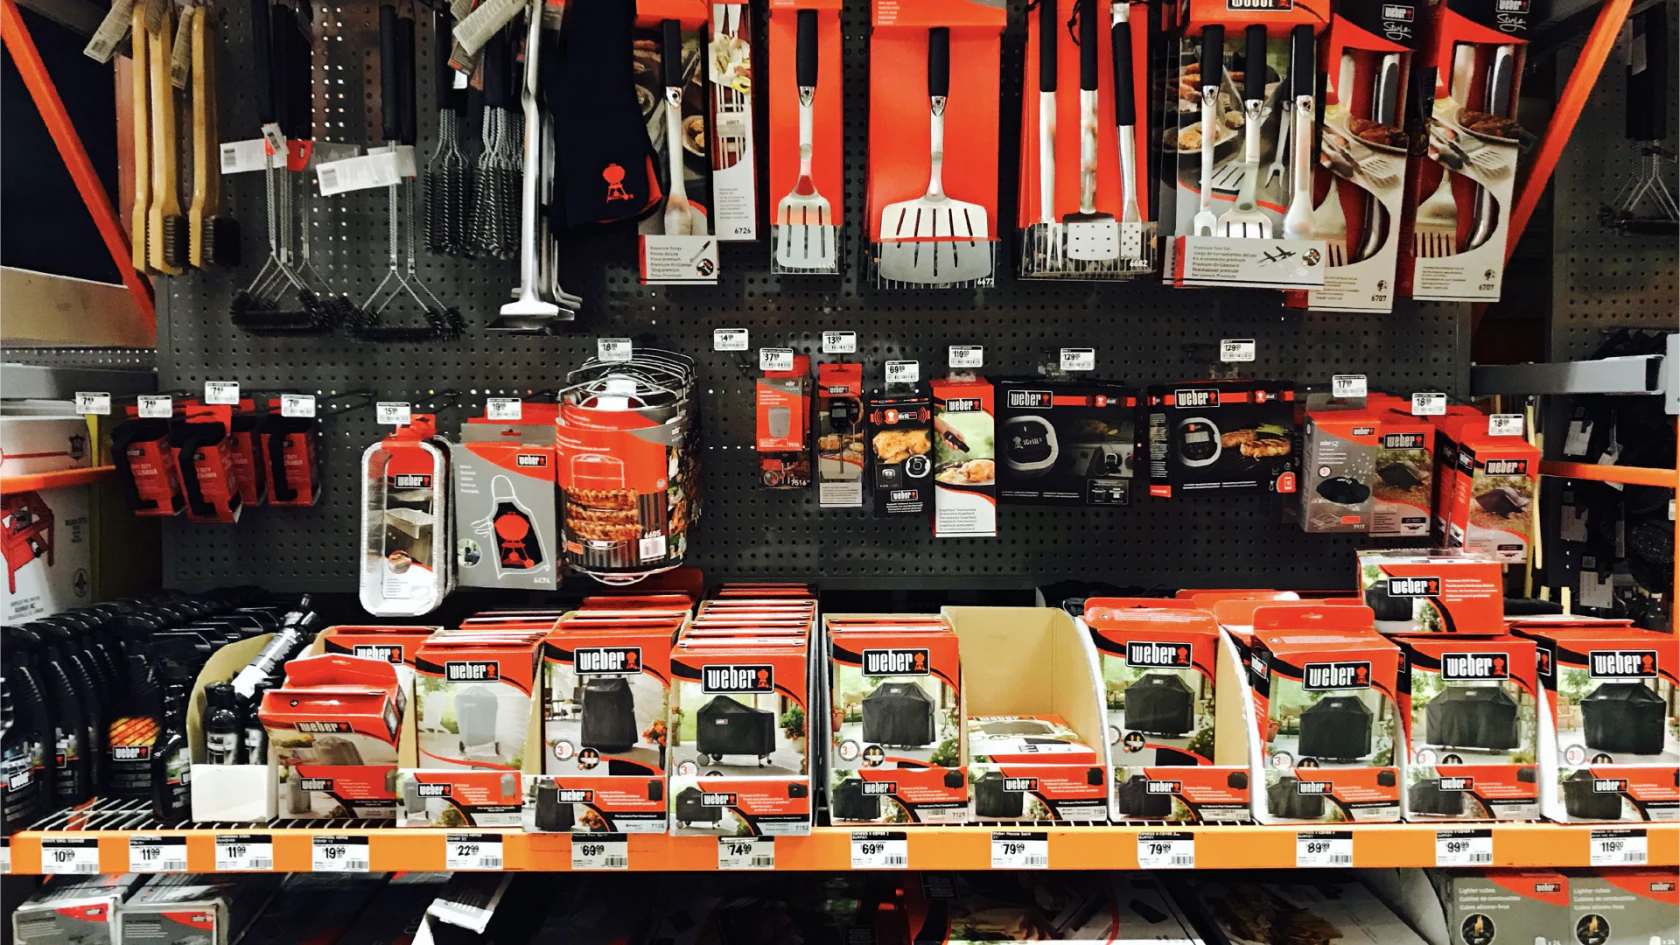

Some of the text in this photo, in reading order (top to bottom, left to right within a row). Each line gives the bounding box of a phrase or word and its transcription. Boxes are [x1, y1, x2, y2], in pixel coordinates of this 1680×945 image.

[1010, 390, 1042, 406] weber
[1178, 389, 1209, 406] weber
[948, 398, 973, 411] weber
[1387, 434, 1415, 448] weber
[519, 454, 539, 466] weber
[1488, 460, 1518, 473] weber
[397, 474, 423, 487] weber
[893, 490, 911, 500] weber
[1391, 578, 1428, 593] weber
[356, 645, 390, 661] weber
[579, 648, 625, 670] weber
[1132, 642, 1177, 664] weber
[868, 649, 914, 672] weber
[1446, 653, 1492, 677] weber
[1594, 651, 1642, 674] weber
[450, 662, 486, 679] weber
[1309, 663, 1355, 687] weber
[708, 665, 756, 689] weber
[300, 722, 338, 732] weber
[115, 746, 140, 758] weber
[302, 778, 326, 790] weber
[864, 781, 889, 794] weber
[1006, 778, 1030, 790] weber
[1150, 781, 1173, 793] weber
[1300, 782, 1325, 793] weber
[1441, 777, 1466, 789] weber
[1595, 779, 1620, 791] weber
[419, 784, 444, 796] weber
[560, 789, 585, 801] weber
[704, 793, 729, 805] weber
[1459, 887, 1478, 895] Lighter
[1535, 883, 1555, 892] weber
[1573, 887, 1593, 895] Lighter
[1651, 882, 1670, 891] weber
